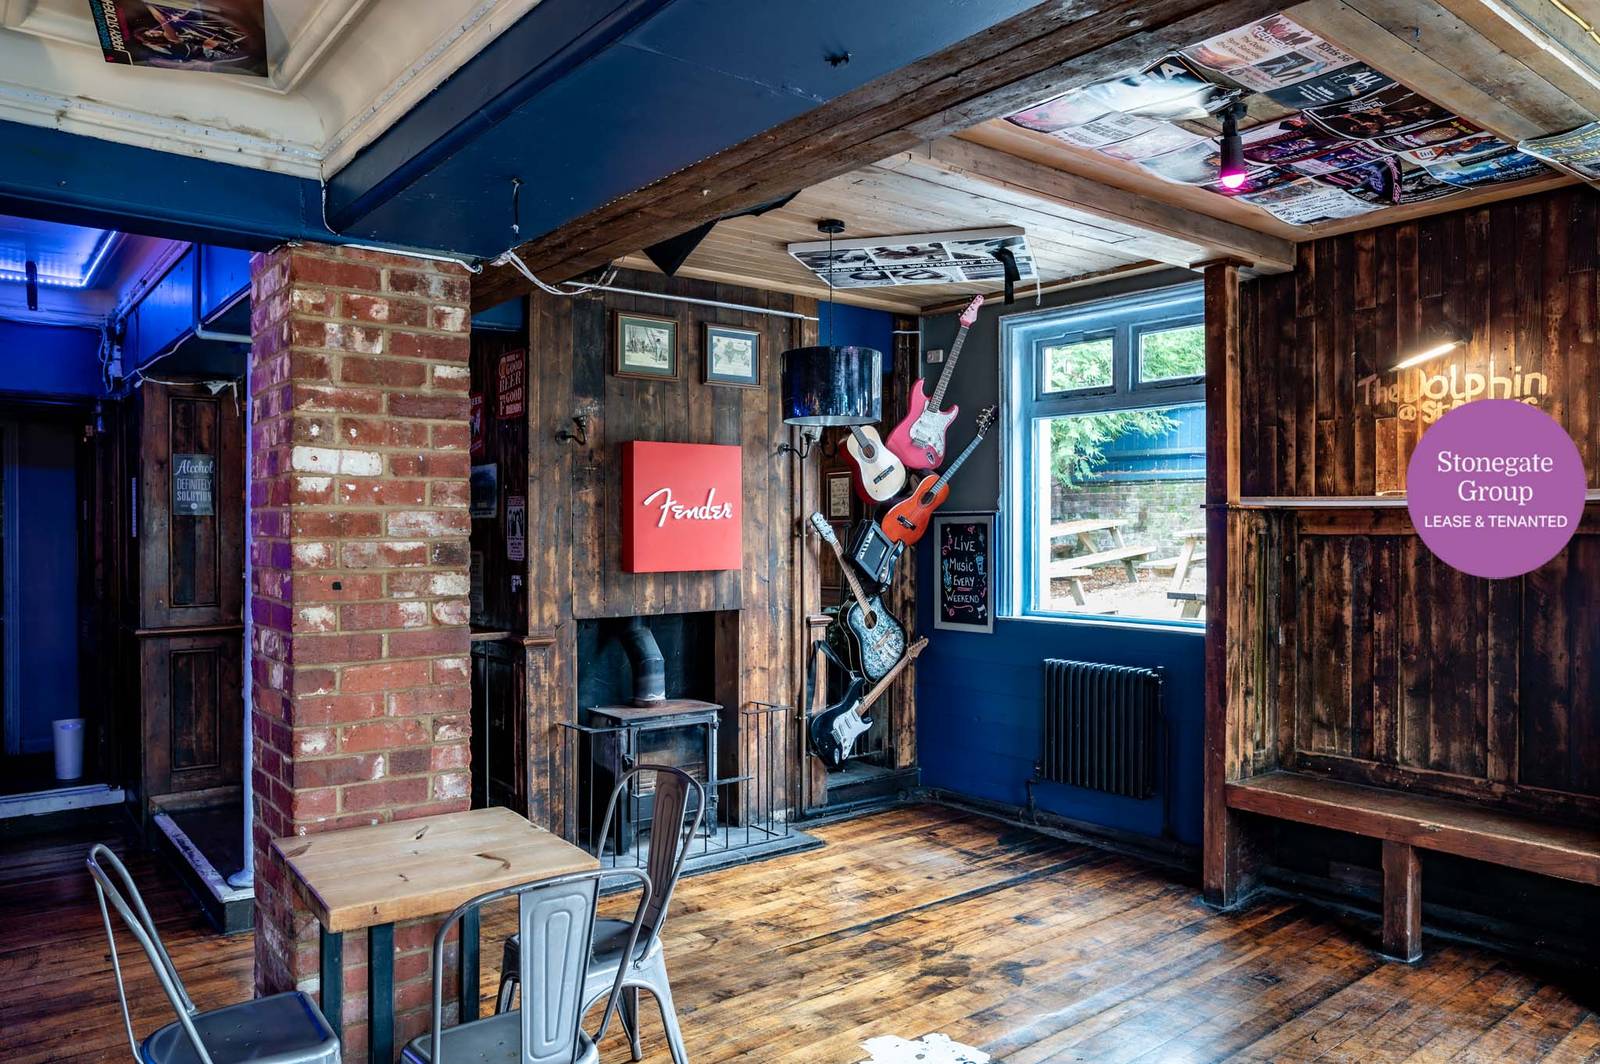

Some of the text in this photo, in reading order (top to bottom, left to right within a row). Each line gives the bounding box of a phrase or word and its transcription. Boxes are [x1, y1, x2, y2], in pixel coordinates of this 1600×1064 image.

[1357, 373, 1398, 406] The
[173, 459, 214, 475] Alcohol
[176, 478, 212, 490] DEFINITELY
[643, 487, 733, 528] Fender
[945, 590, 980, 603] WEEKEND
